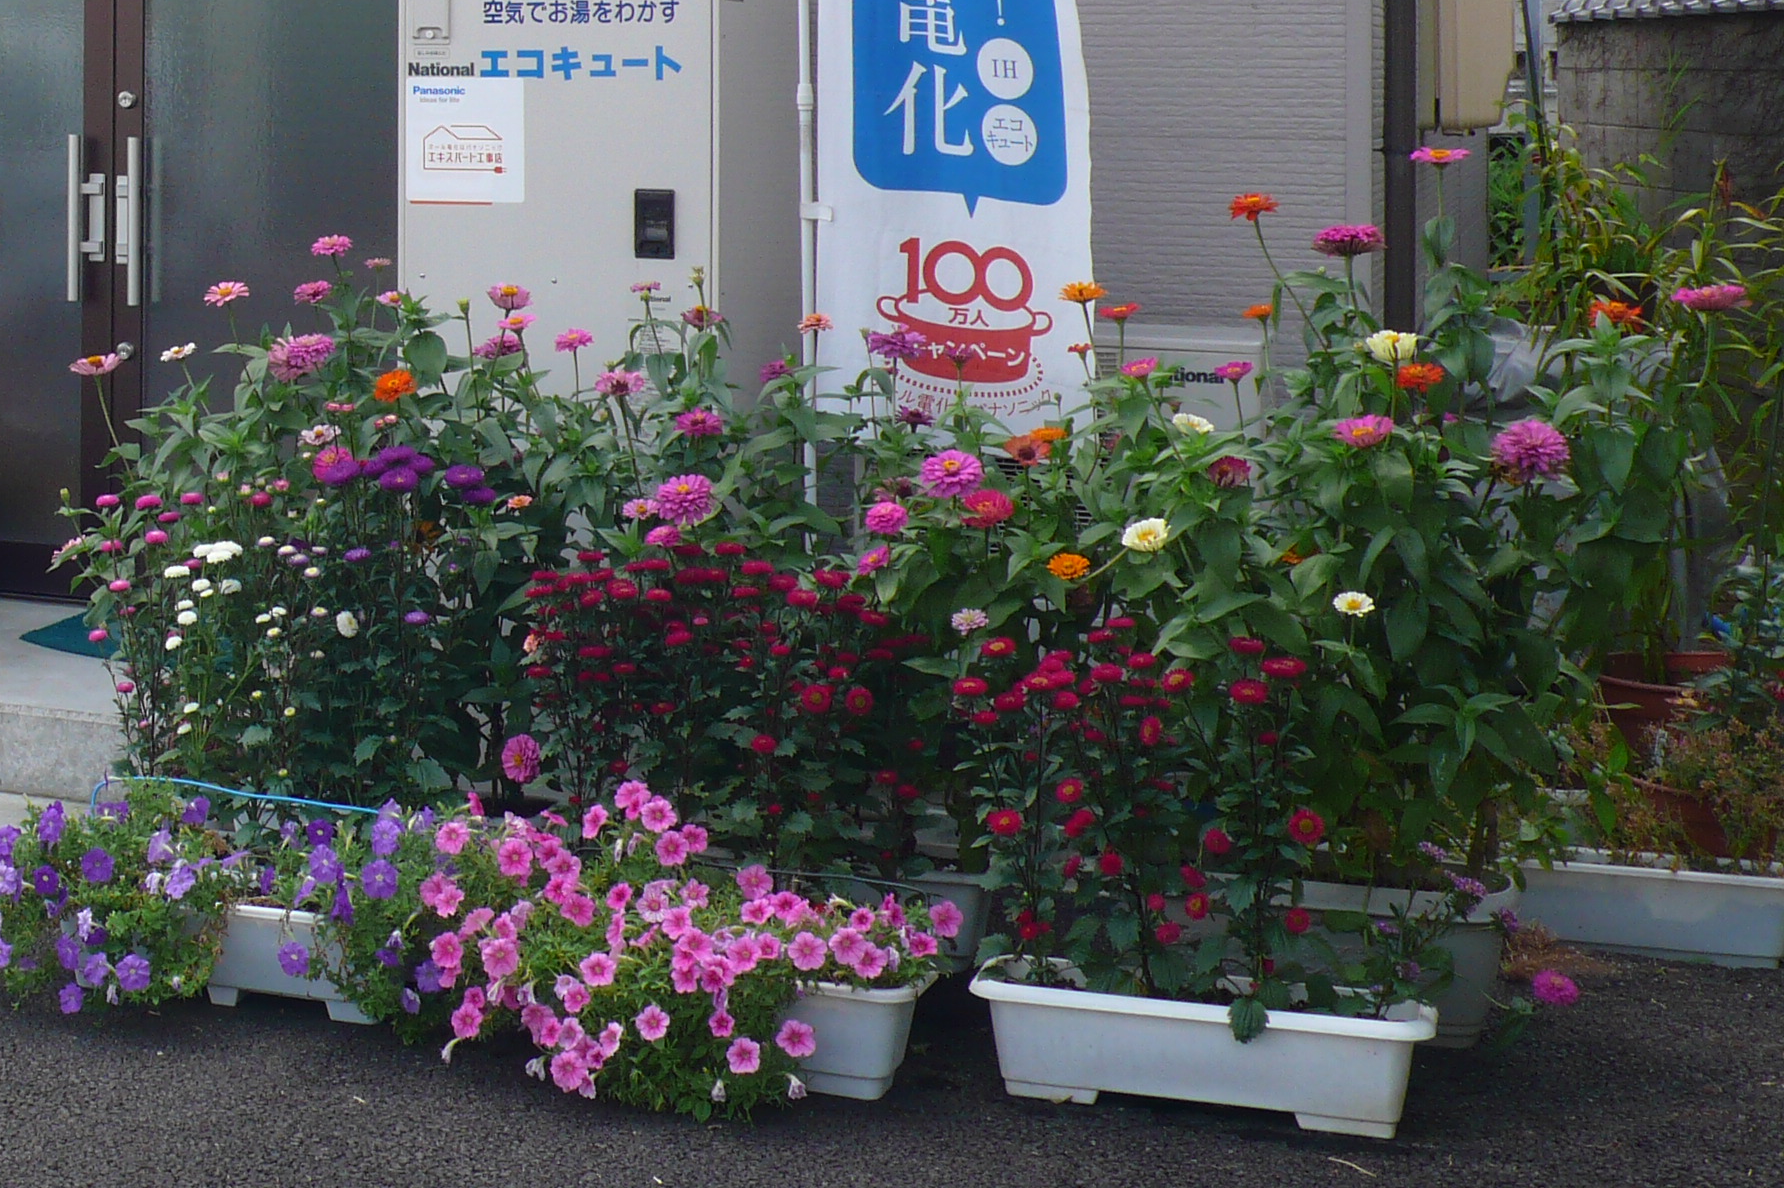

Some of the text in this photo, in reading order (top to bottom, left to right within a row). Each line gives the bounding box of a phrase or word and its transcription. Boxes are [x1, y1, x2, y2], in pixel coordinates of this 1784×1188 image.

[408, 62, 475, 77] National
[480, 45, 682, 81] エコキュート
[991, 59, 1018, 81] IH
[413, 85, 466, 96] Panasonic
[428, 152, 503, 164] エキスパート工事店
[899, 238, 1035, 312] 100
[948, 307, 990, 328] 万人
